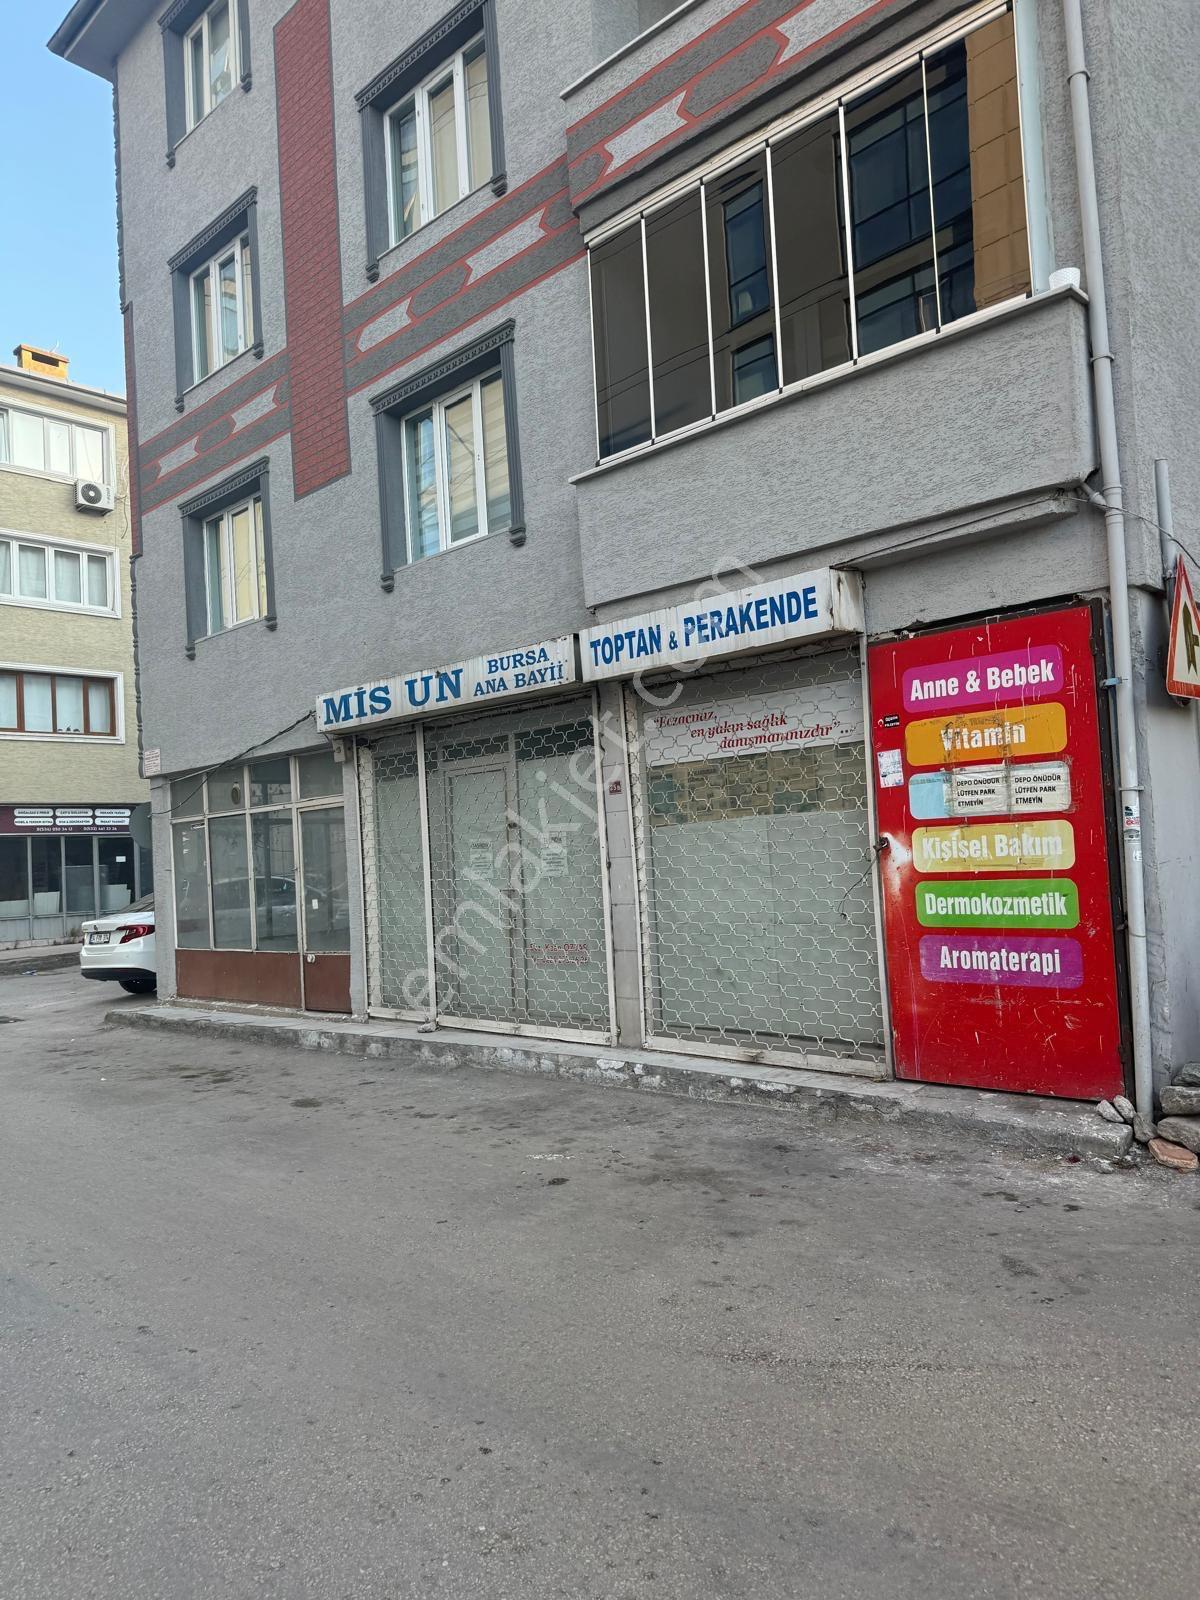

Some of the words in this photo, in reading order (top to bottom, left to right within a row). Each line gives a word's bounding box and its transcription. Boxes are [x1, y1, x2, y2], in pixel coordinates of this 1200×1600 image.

[590, 625, 661, 666] TOPTAN
[668, 631, 679, 650] &
[683, 586, 818, 647] PERAKENDE
[487, 648, 549, 674] BURSA
[473, 678, 508, 697] ANA
[911, 677, 959, 701] Anne
[965, 670, 981, 693] &
[986, 659, 1055, 690] Bebek
[323, 685, 392, 725] MİS
[404, 669, 463, 707] UN
[690, 728, 705, 738] en
[940, 722, 1026, 751] Vitamin
[956, 779, 973, 787] DEPO
[1014, 775, 1031, 784] DEPO
[1032, 774, 1062, 783] ÖNÜDÜR
[1014, 785, 1038, 794] LÜTFEN
[1039, 785, 1057, 793] PARK
[957, 788, 979, 797] LÜTFEN
[979, 788, 996, 796] PARK
[957, 798, 984, 807] ETMEYİN
[1015, 795, 1043, 805] ETMEYİN
[922, 835, 989, 861] Kişisel
[994, 832, 1063, 857] Bakım
[924, 892, 1068, 916] Dermokozmetik
[940, 945, 1062, 975] Aromaterapi
